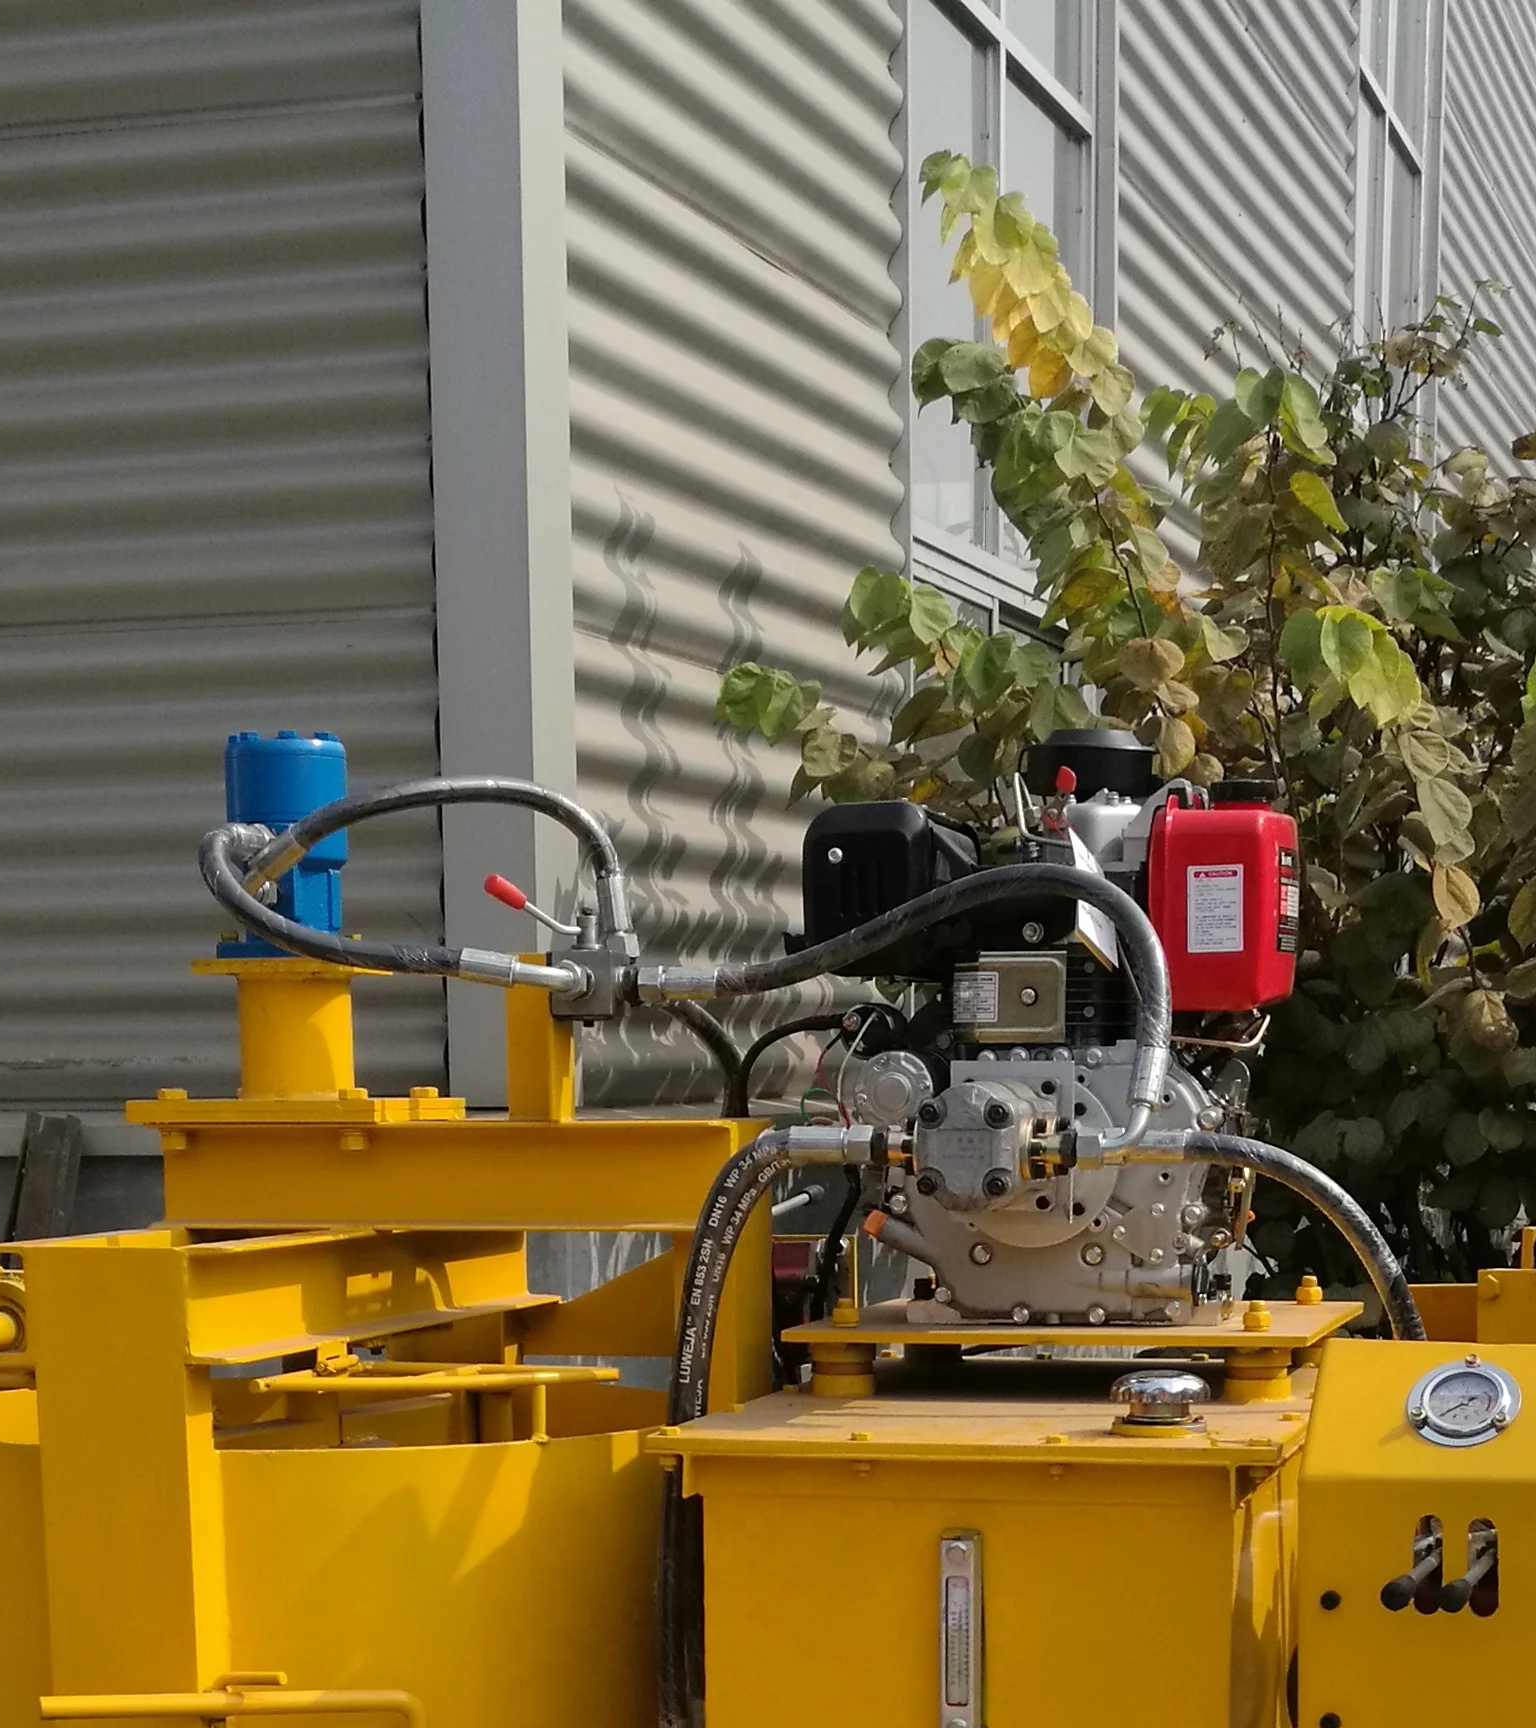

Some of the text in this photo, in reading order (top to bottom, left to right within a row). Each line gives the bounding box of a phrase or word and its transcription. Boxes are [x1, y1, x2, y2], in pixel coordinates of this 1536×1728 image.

[738, 1156, 753, 1171] 34
[724, 1169, 741, 1189] WP
[708, 1195, 728, 1229] DN16
[721, 1225, 734, 1246] WP
[730, 1210, 743, 1226] 34
[740, 1188, 757, 1211] MPa
[699, 1238, 715, 1263] 2SN
[694, 1265, 707, 1286] 853
[691, 1288, 703, 1306] EN
